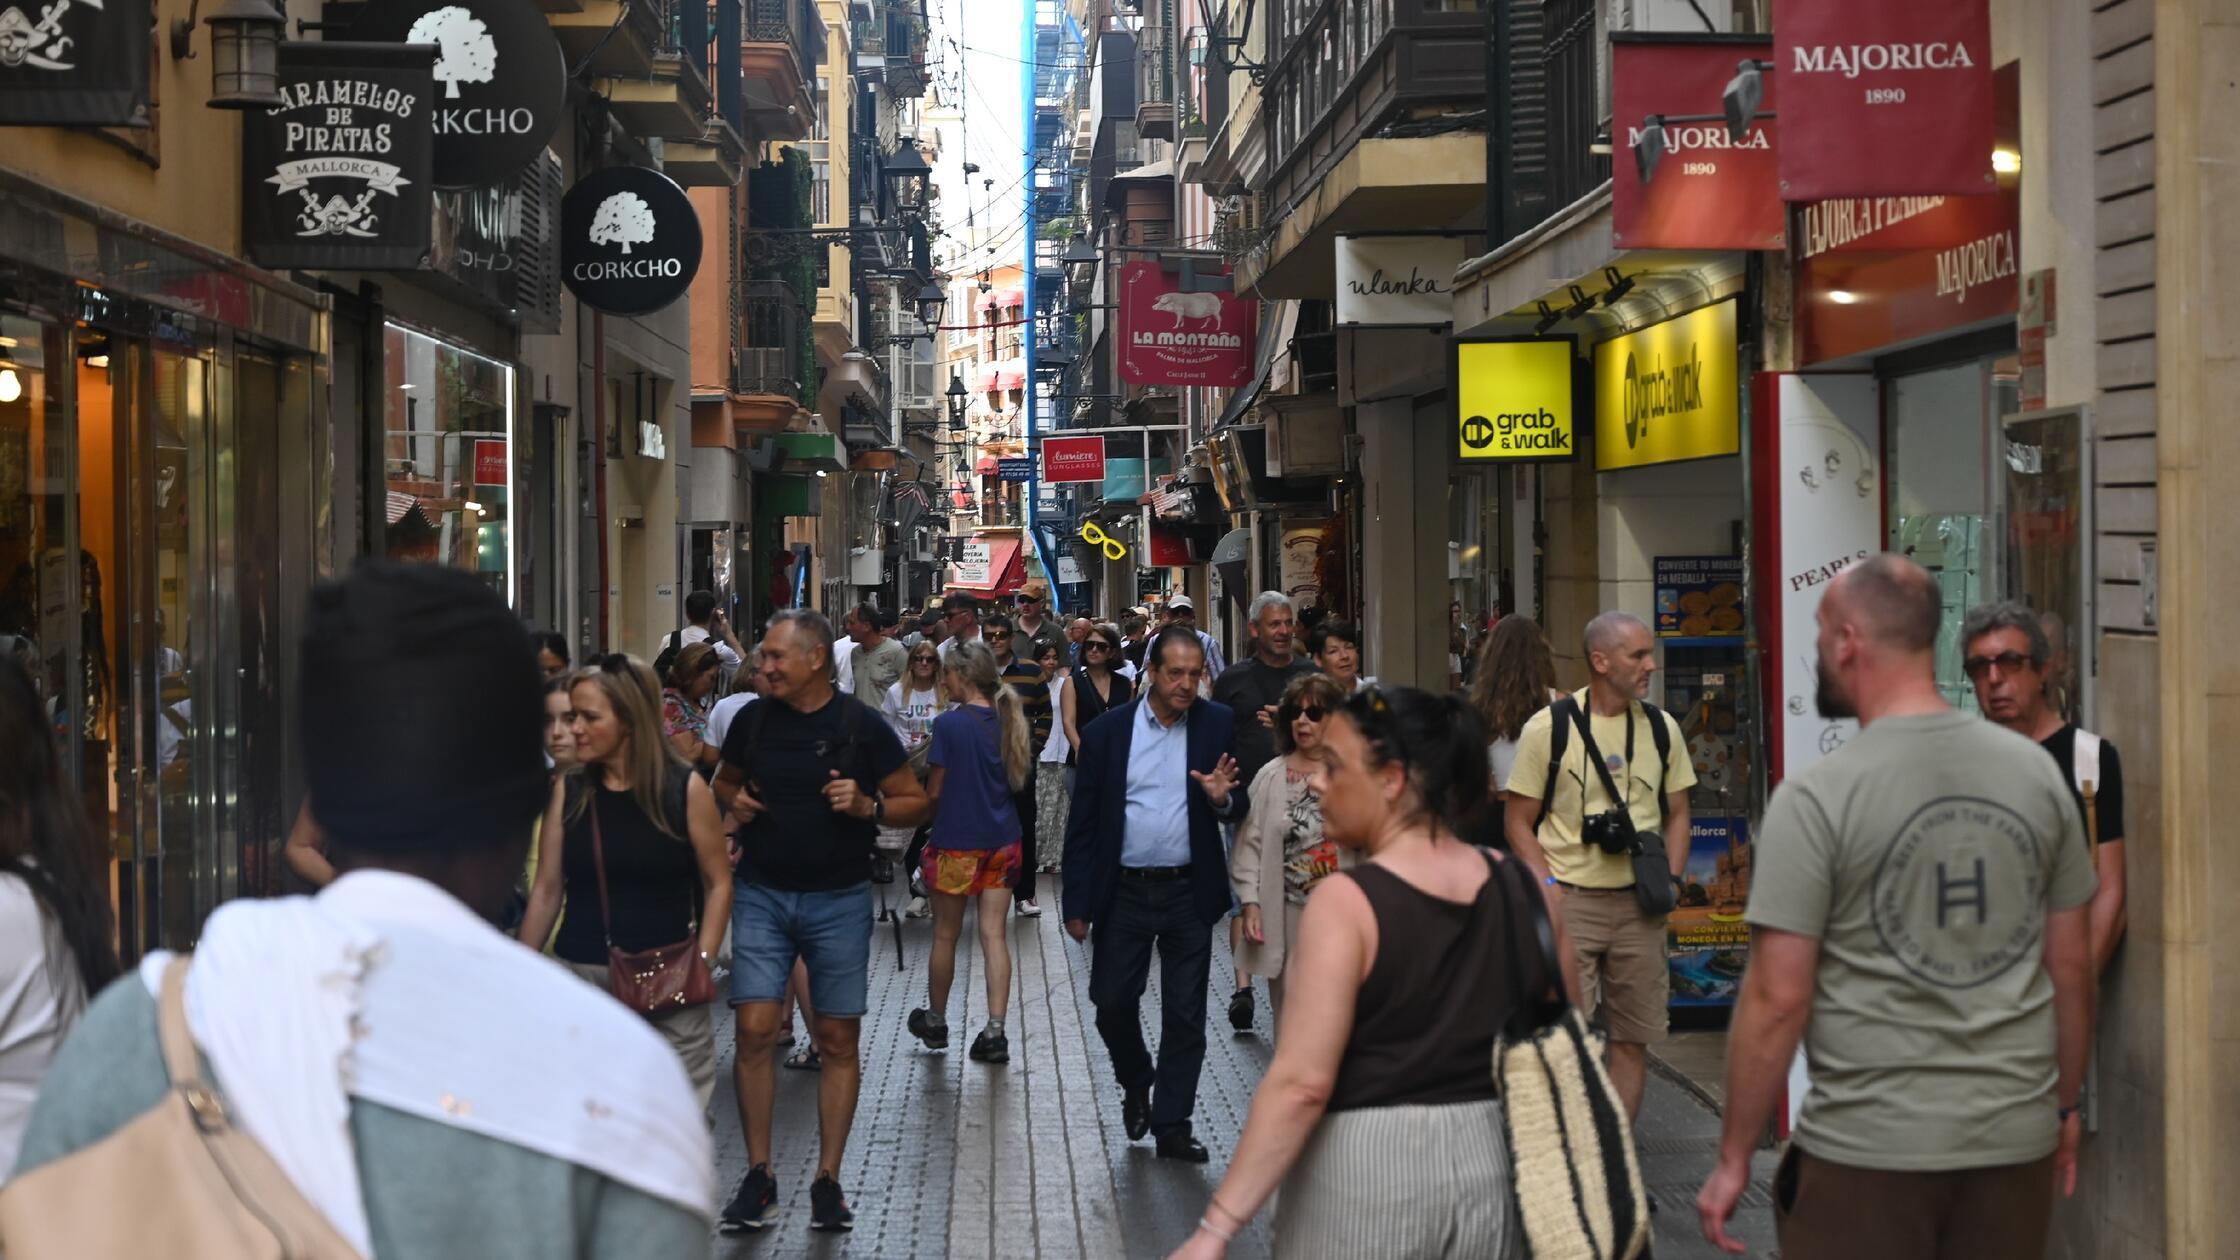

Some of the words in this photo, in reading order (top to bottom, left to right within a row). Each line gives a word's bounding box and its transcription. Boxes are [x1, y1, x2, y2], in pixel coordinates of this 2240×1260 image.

[1793, 42, 1974, 78] MAJORICA
[266, 80, 416, 117] ARAMELOS
[1865, 88, 1905, 104] 1890
[326, 107, 353, 125] DE
[285, 122, 391, 153] PIRATAS
[295, 161, 380, 177] MALLORCA
[1683, 162, 1716, 175] 1890
[573, 258, 682, 281] CORKCHO
[1935, 229, 2016, 304] MAJORICA
[1133, 331, 1153, 345] LA
[1497, 407, 1555, 435] grab
[1049, 462, 1101, 470] SUNGLASSES
